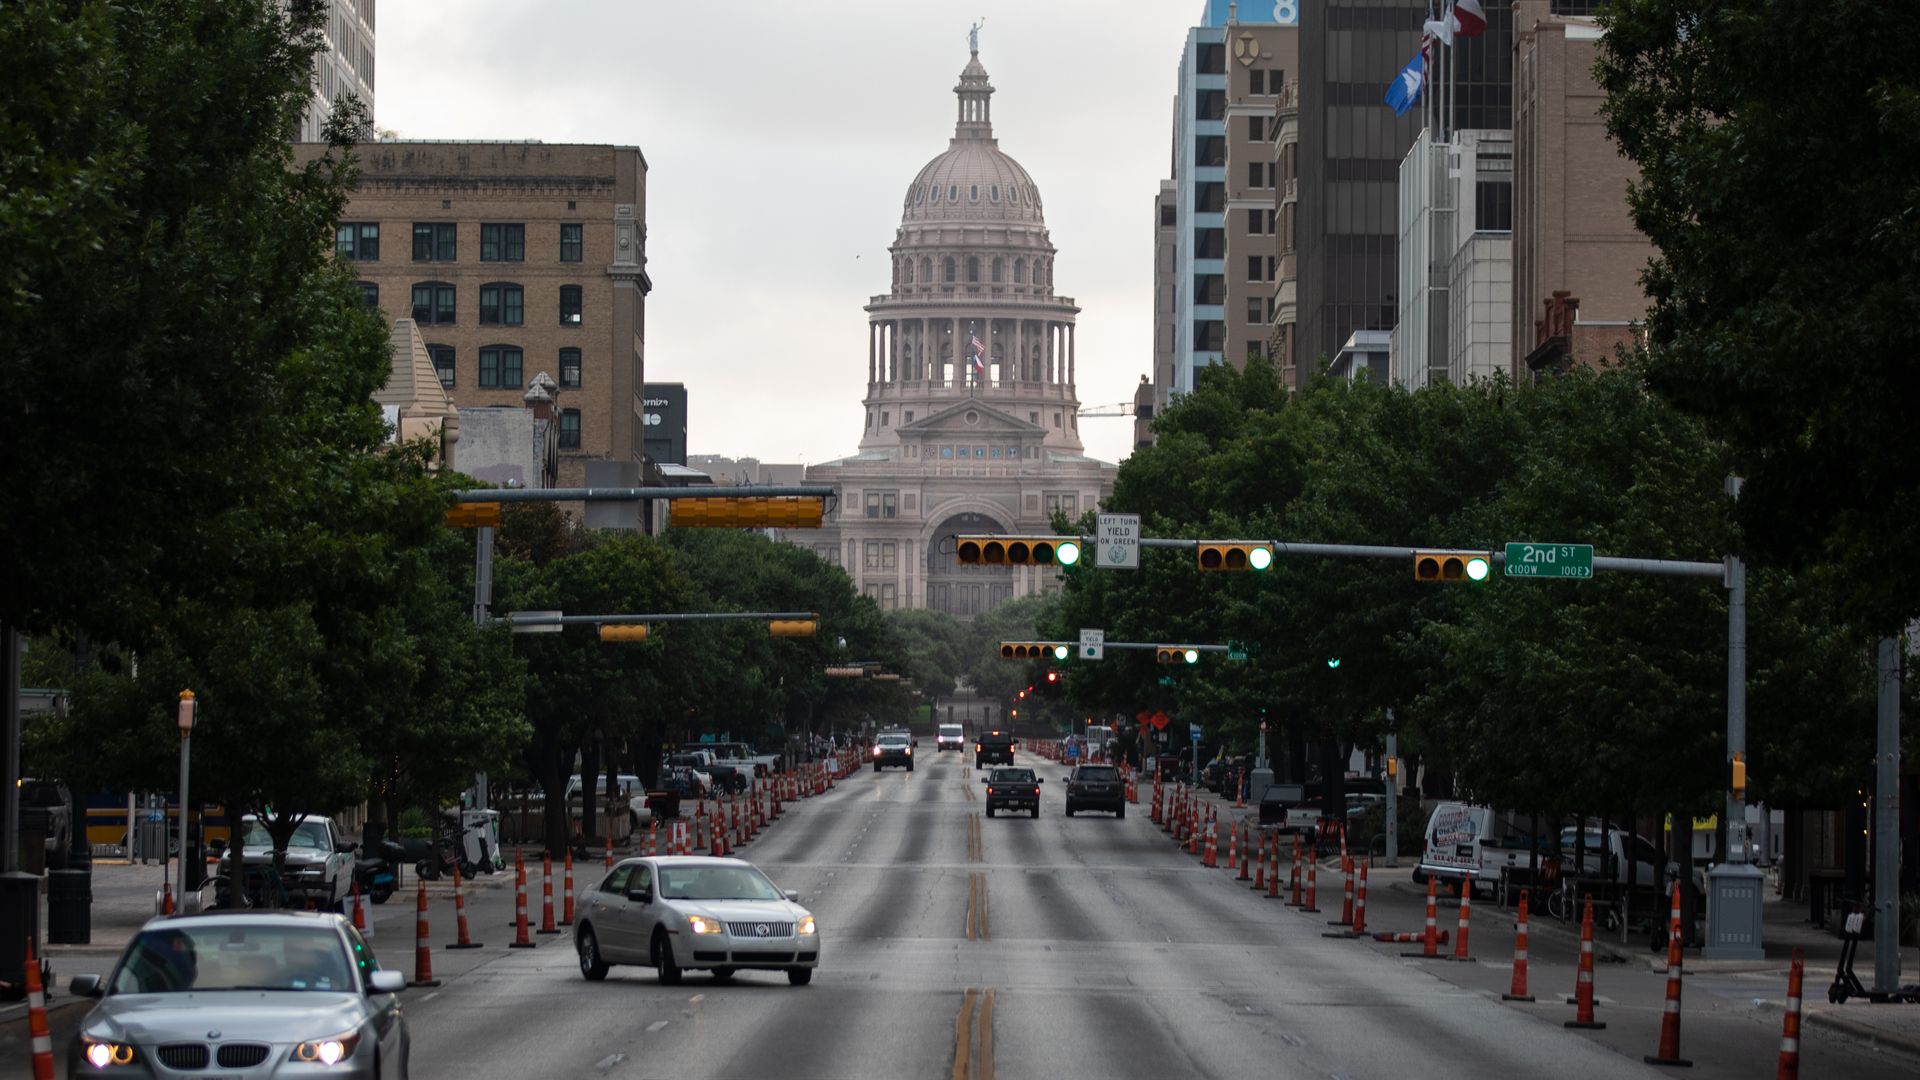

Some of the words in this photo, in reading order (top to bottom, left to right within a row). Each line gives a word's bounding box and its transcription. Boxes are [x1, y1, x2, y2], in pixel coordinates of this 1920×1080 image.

[1107, 527, 1130, 536] YIELD
[1100, 537, 1110, 545] ON
[1113, 537, 1136, 545] GREEN
[1523, 545, 1556, 563] 2nd
[1561, 546, 1576, 558] ST
[1514, 564, 1537, 575] 100W
